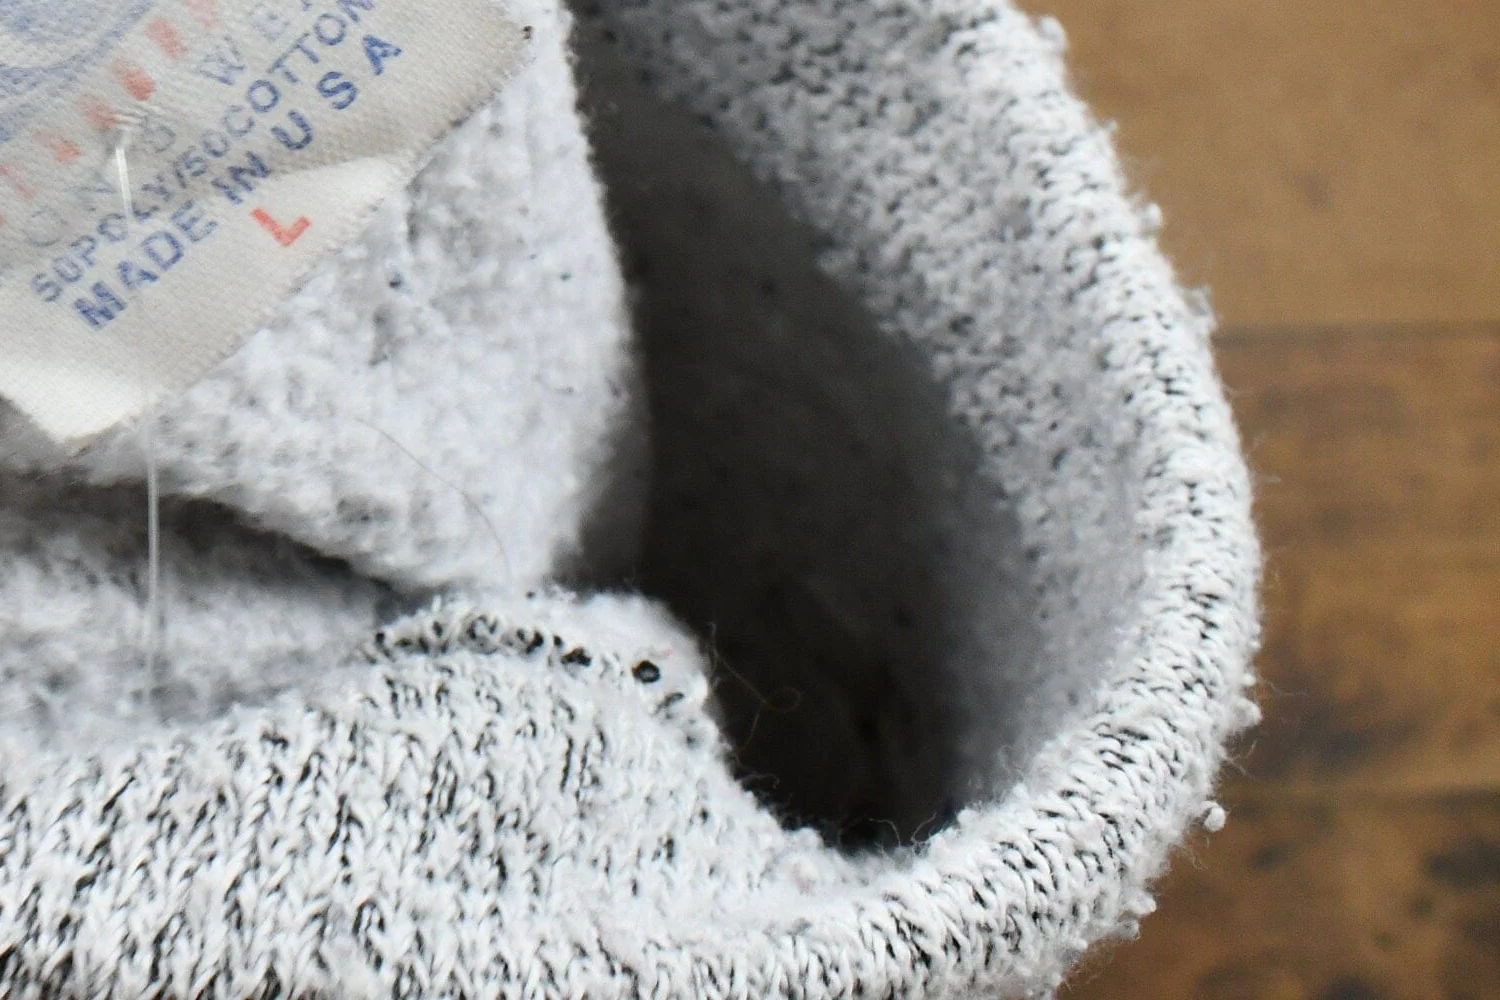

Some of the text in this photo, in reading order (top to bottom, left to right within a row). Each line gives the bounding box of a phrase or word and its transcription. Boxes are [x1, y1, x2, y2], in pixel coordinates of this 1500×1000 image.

[74, 199, 219, 330] MADE
[211, 151, 271, 204] IN
[252, 207, 313, 248] L
